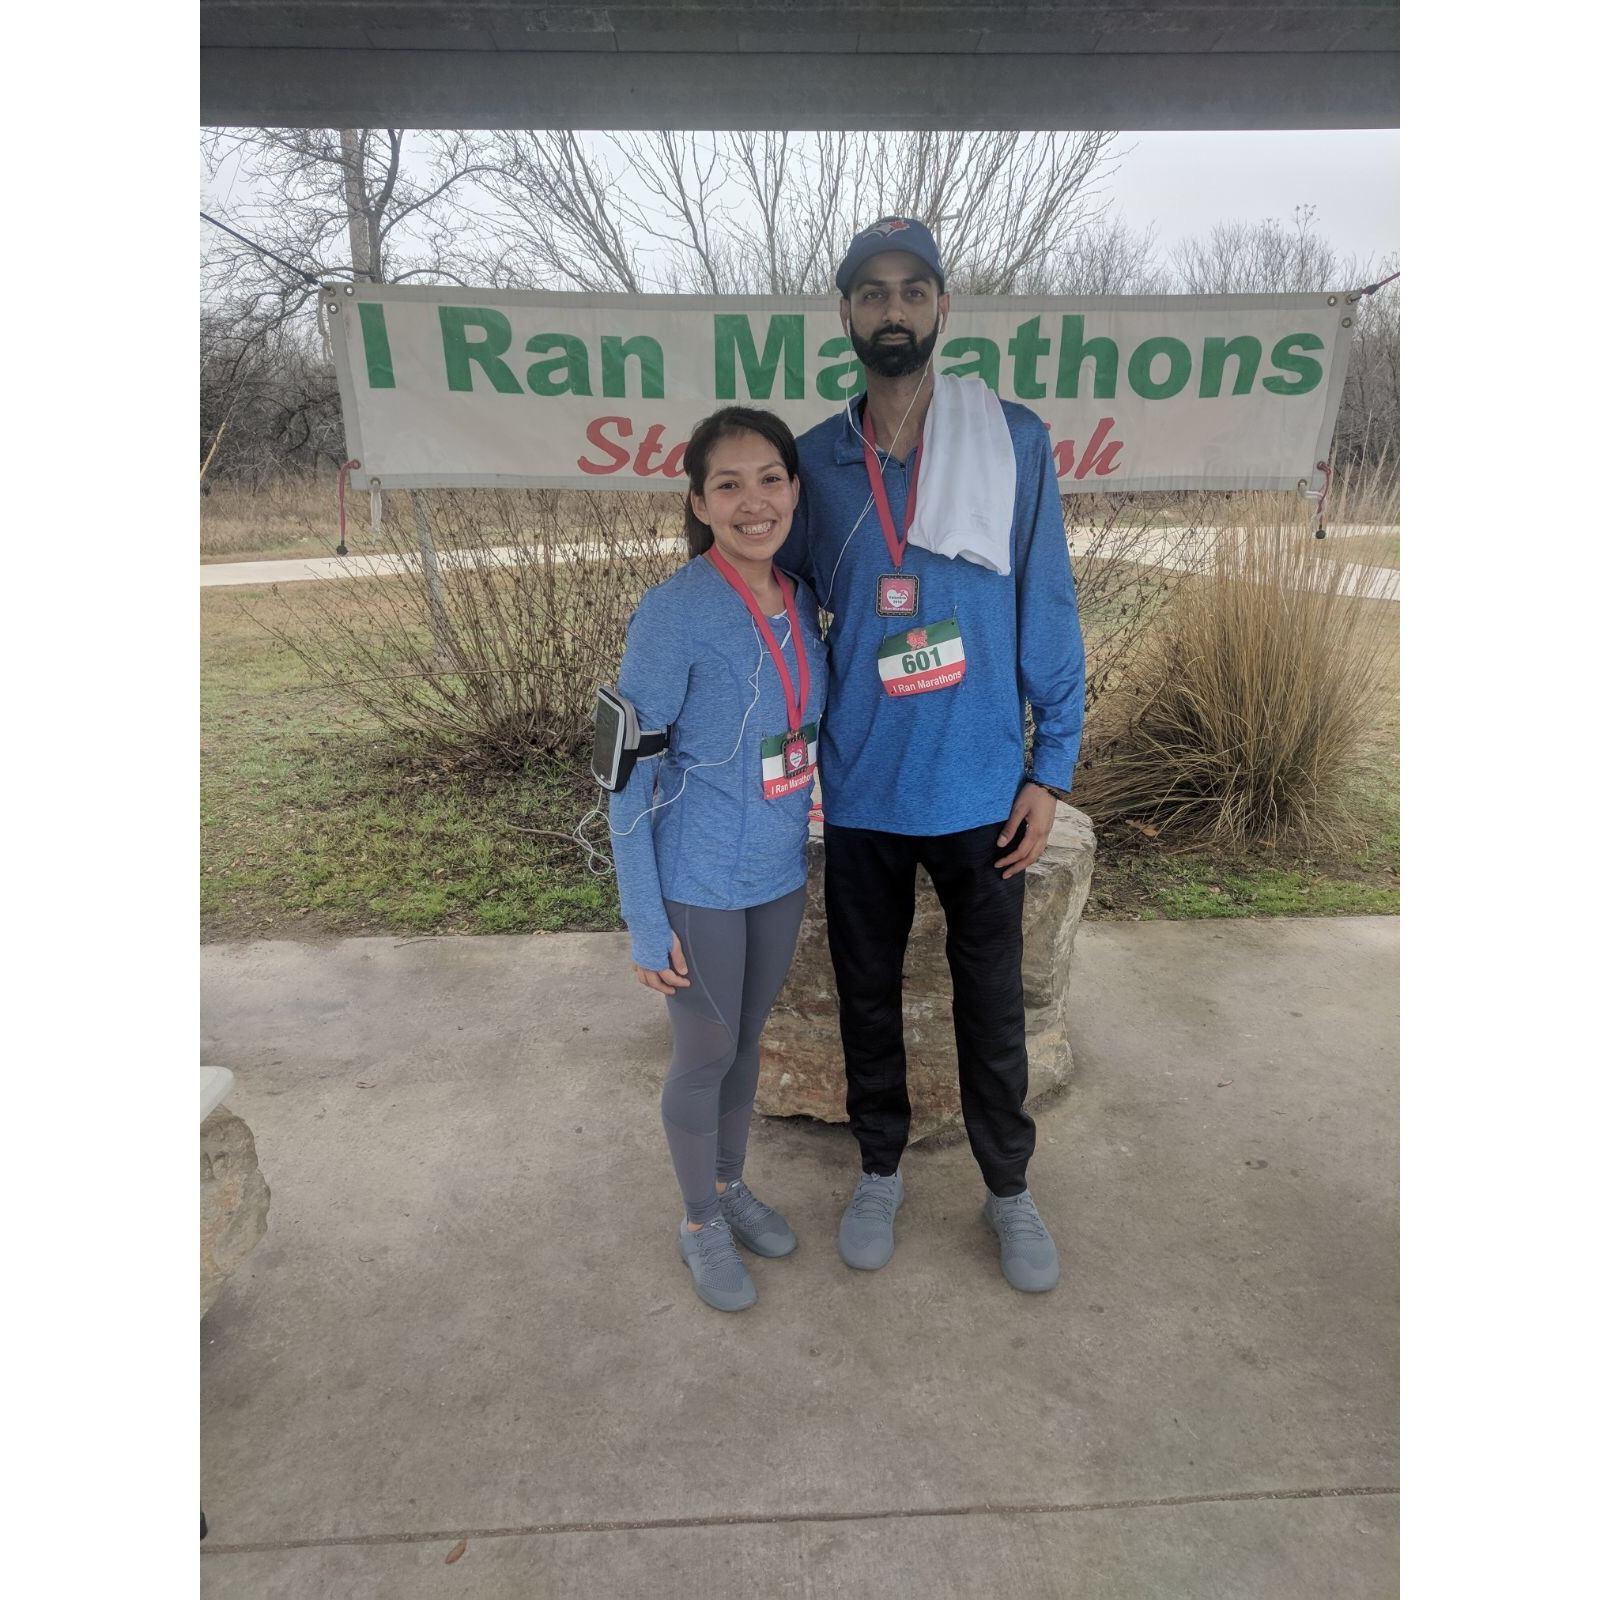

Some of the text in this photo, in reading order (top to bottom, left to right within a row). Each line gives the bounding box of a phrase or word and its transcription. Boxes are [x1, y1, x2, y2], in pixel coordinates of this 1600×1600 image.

[357, 302, 1326, 401] I Ran Maathons
[901, 646, 942, 675] 601
[898, 683, 916, 693] Ran
[917, 670, 962, 690] Marathons
[775, 784, 789, 794] Ran
